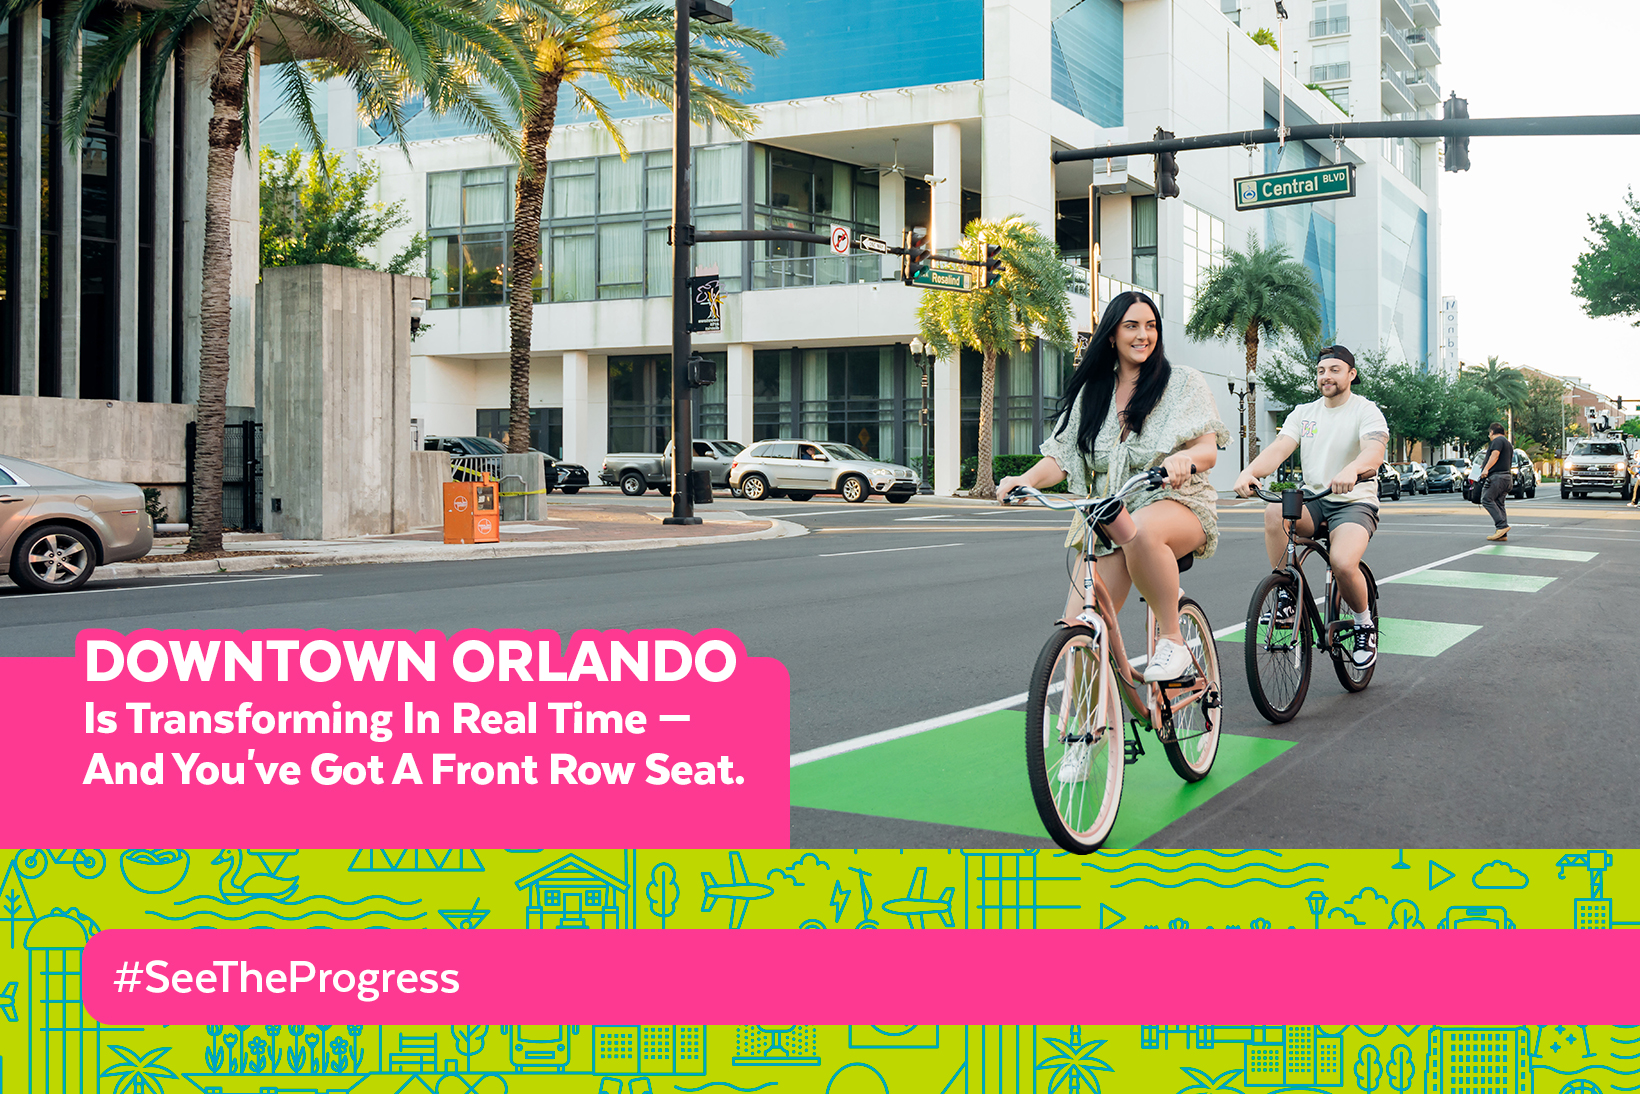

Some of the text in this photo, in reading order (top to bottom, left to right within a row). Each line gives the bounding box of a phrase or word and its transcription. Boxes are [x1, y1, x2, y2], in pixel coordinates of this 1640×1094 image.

[1262, 172, 1345, 197] Central BLVD
[931, 272, 960, 286] Rosalind
